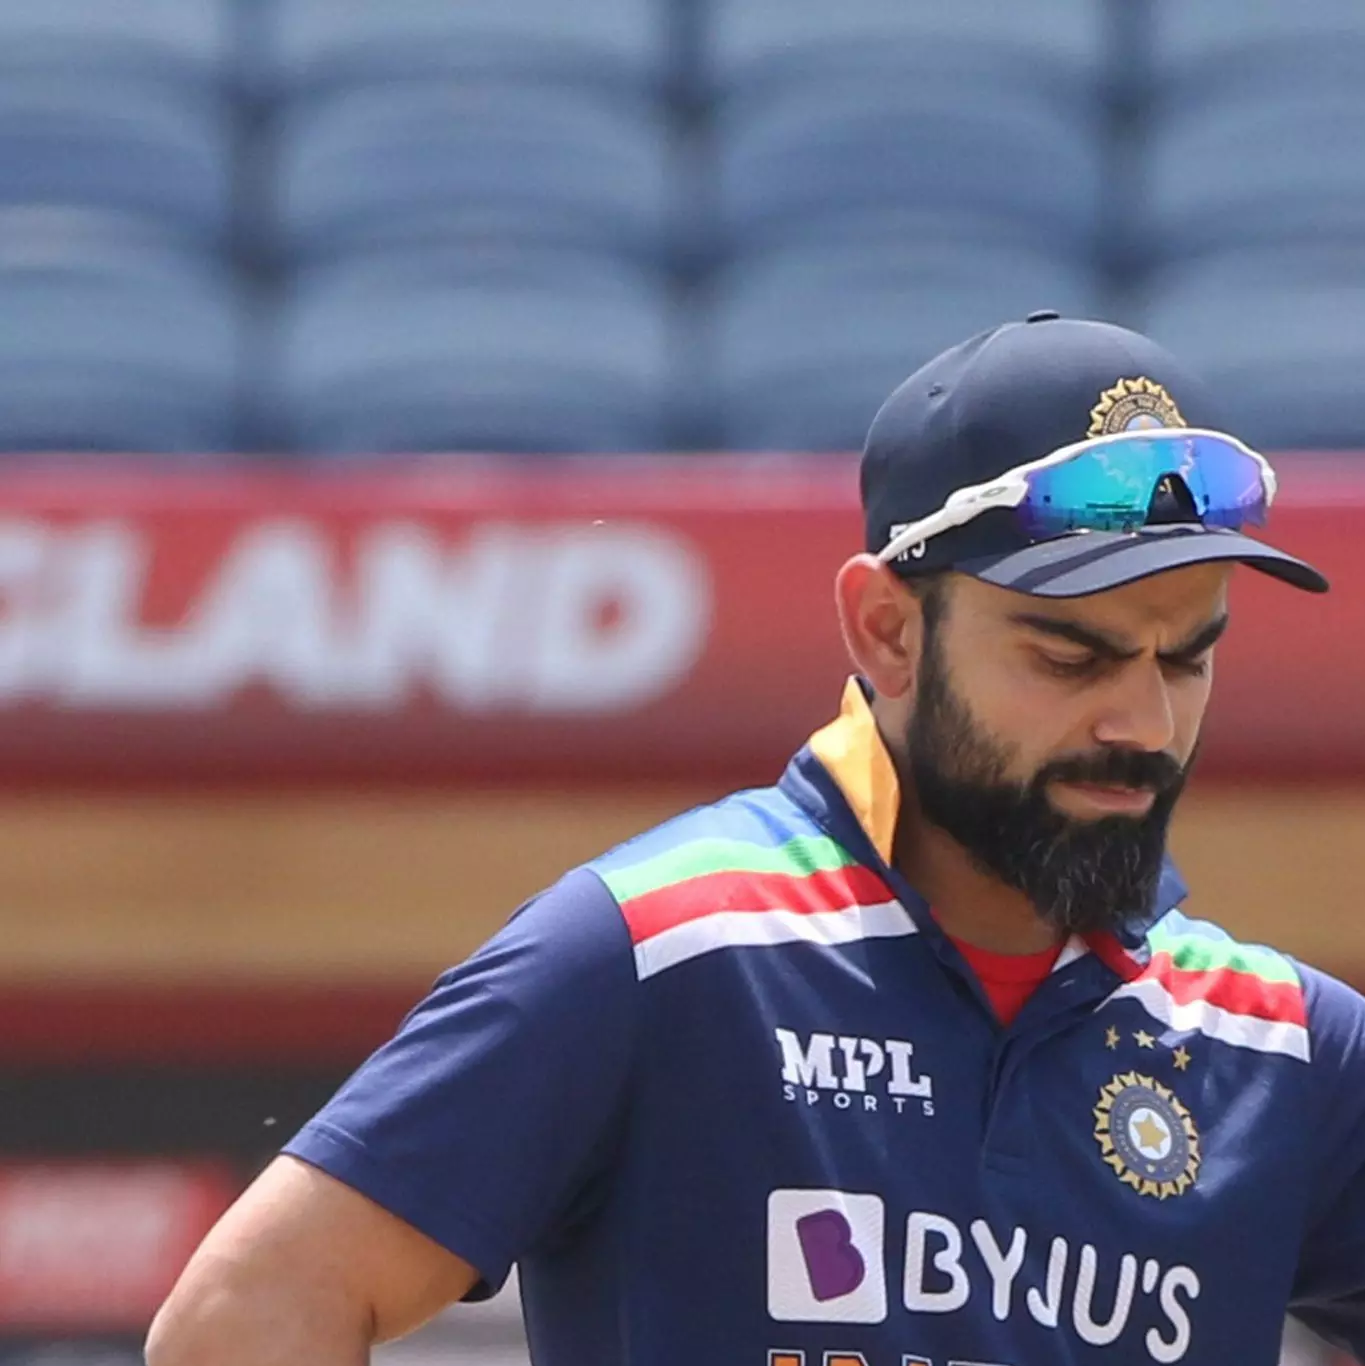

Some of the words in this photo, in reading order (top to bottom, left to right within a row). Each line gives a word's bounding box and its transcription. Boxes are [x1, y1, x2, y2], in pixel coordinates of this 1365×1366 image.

[775, 1027, 933, 1098] MPL
[783, 1084, 935, 1117] SPORTS
[903, 1211, 1200, 1364] BYJU'S
